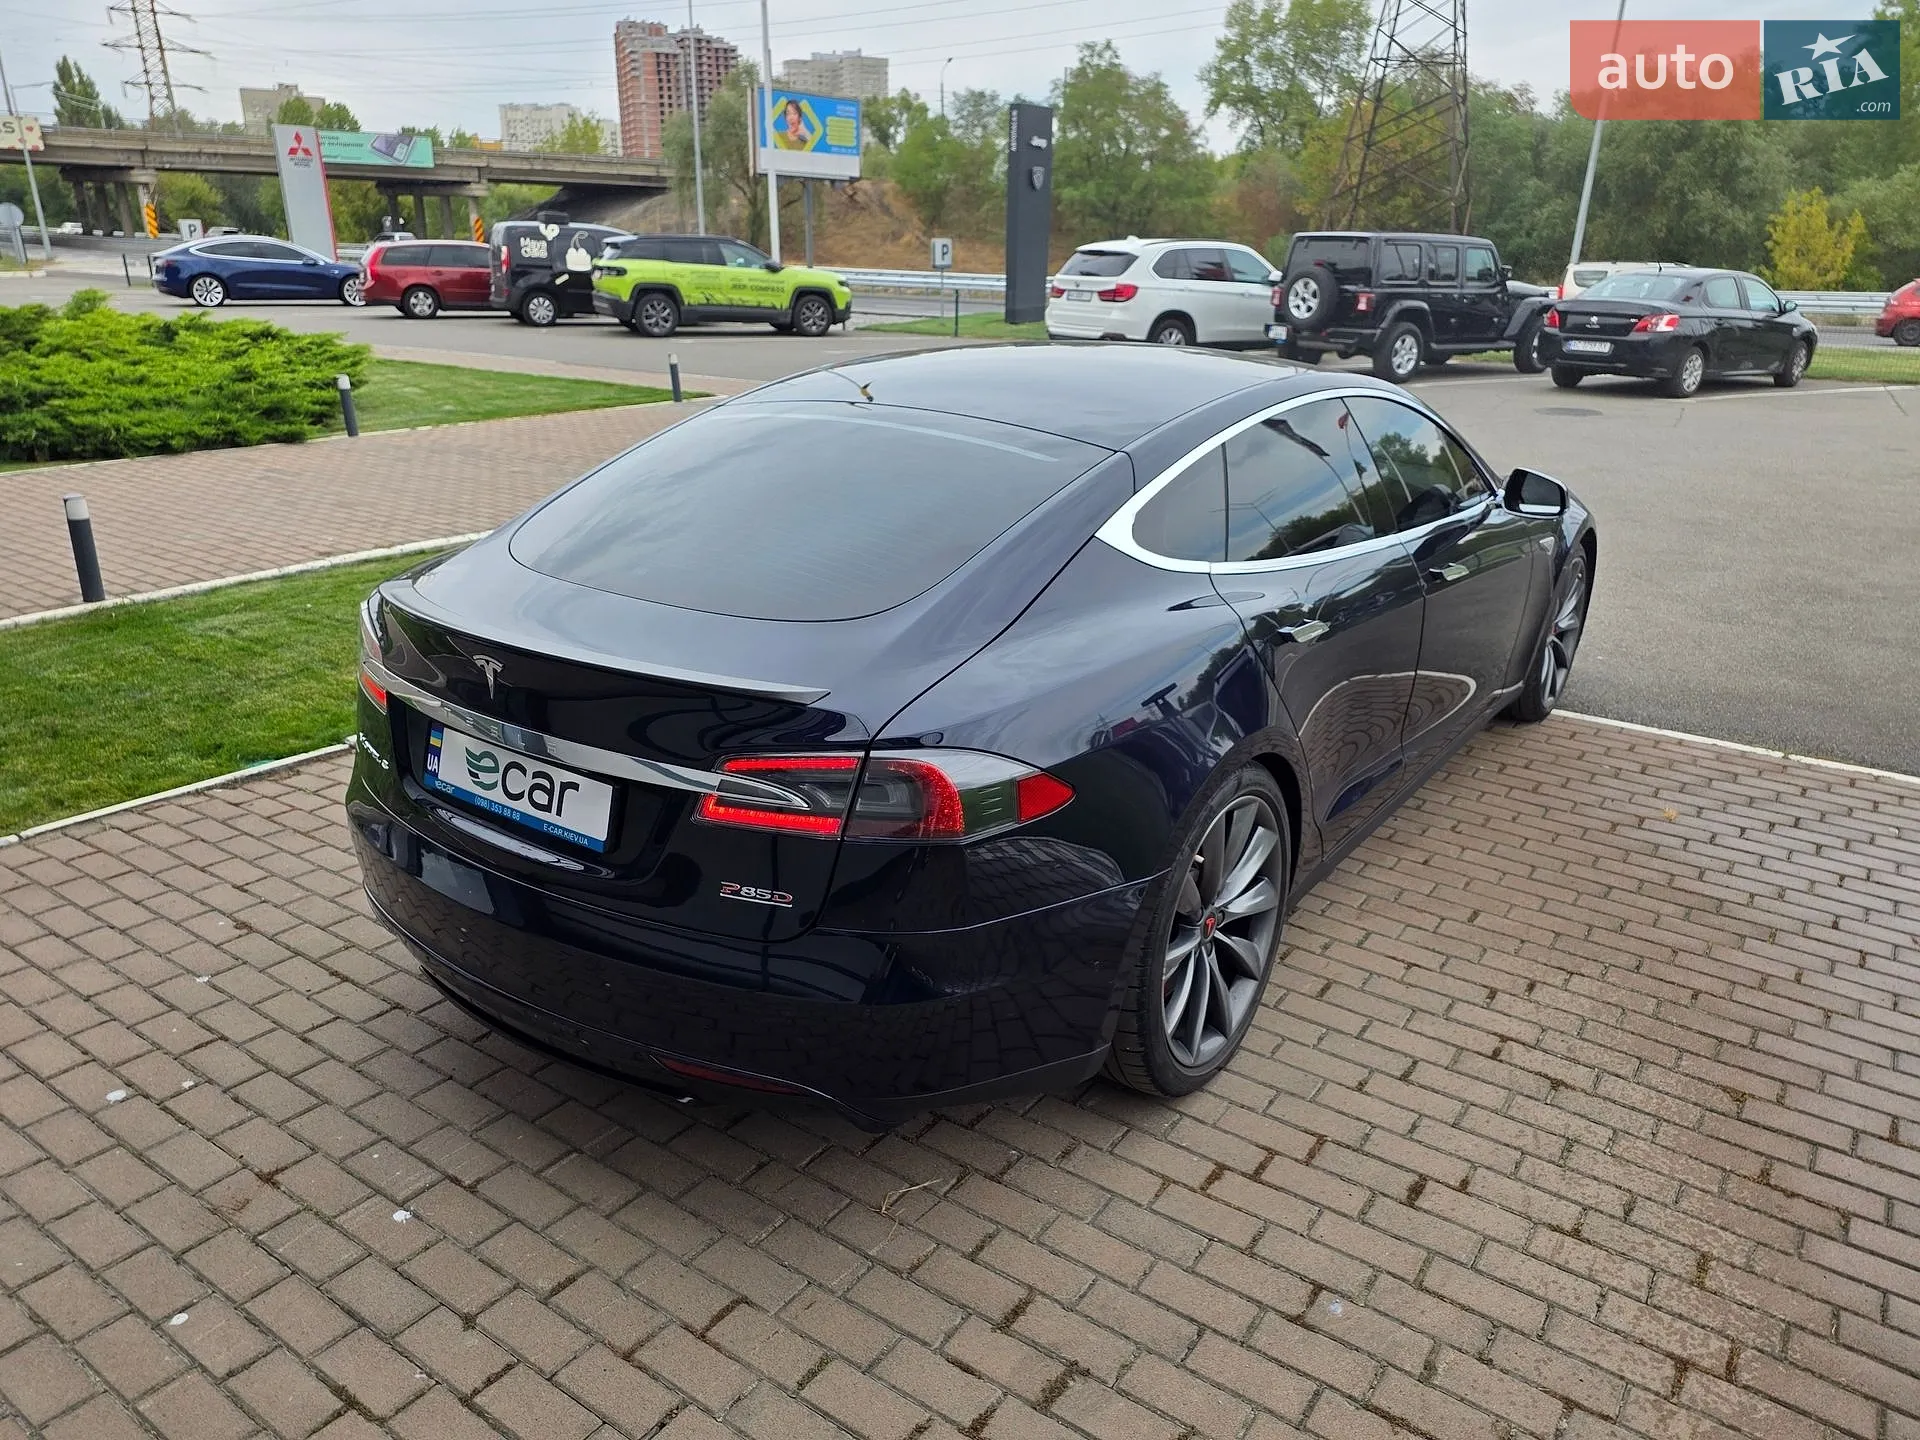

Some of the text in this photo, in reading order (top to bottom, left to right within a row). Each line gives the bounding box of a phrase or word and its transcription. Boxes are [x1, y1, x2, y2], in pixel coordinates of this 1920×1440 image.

[0, 120, 16, 134] S
[188, 223, 198, 238] P
[941, 243, 950, 261] P
[426, 753, 439, 774] UA
[720, 881, 793, 904] P85D
